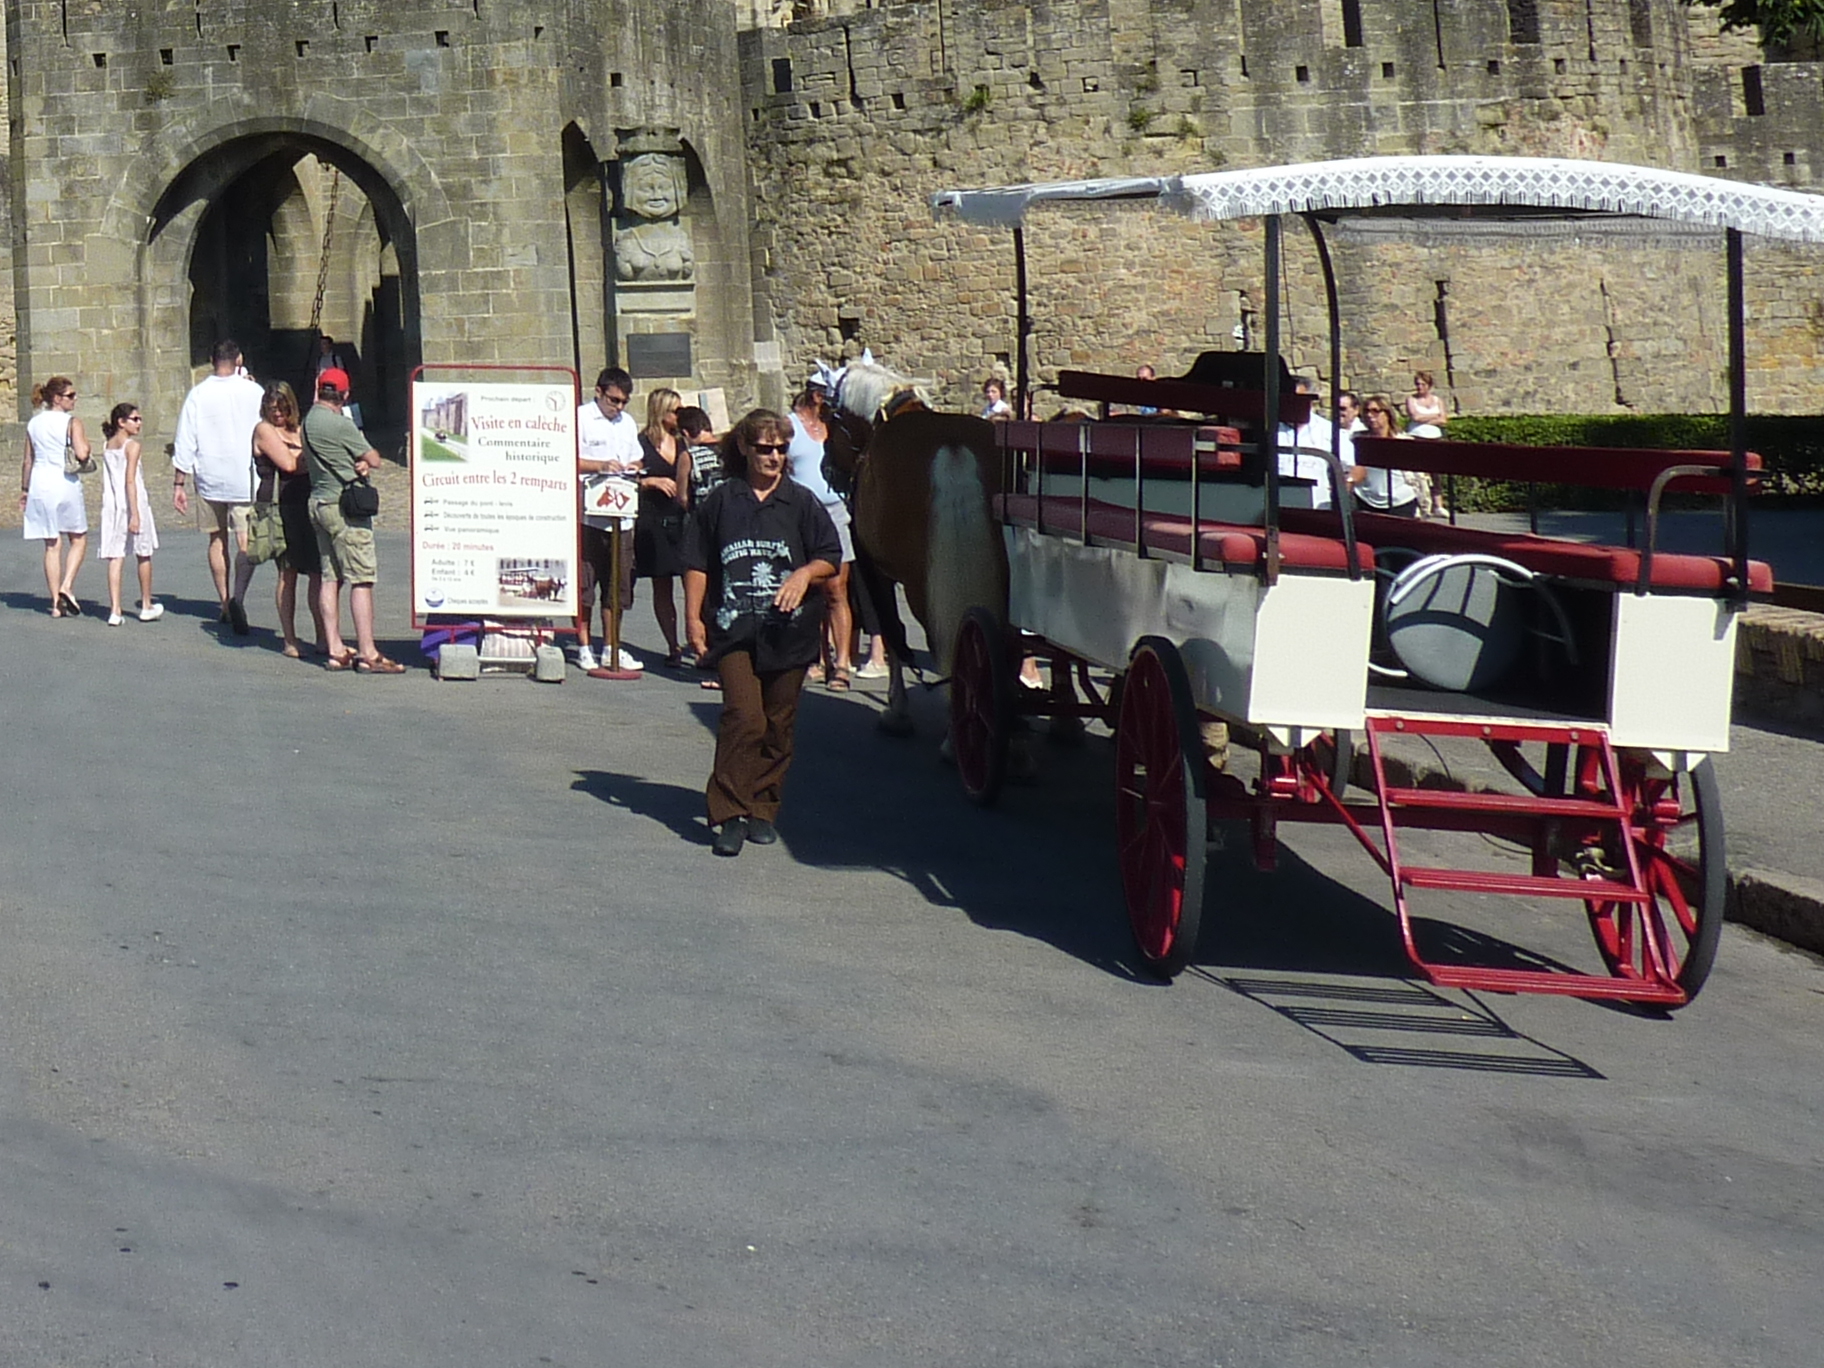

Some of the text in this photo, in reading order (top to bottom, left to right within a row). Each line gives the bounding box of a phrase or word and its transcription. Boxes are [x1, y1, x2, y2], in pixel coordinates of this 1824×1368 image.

[471, 415, 567, 433] Visite en calèche
[478, 436, 551, 448] Commentaire
[505, 451, 560, 464] historique
[422, 470, 567, 492] Circuit entre les 2 remparts
[452, 542, 461, 550] 20
[463, 543, 494, 551] minutes
